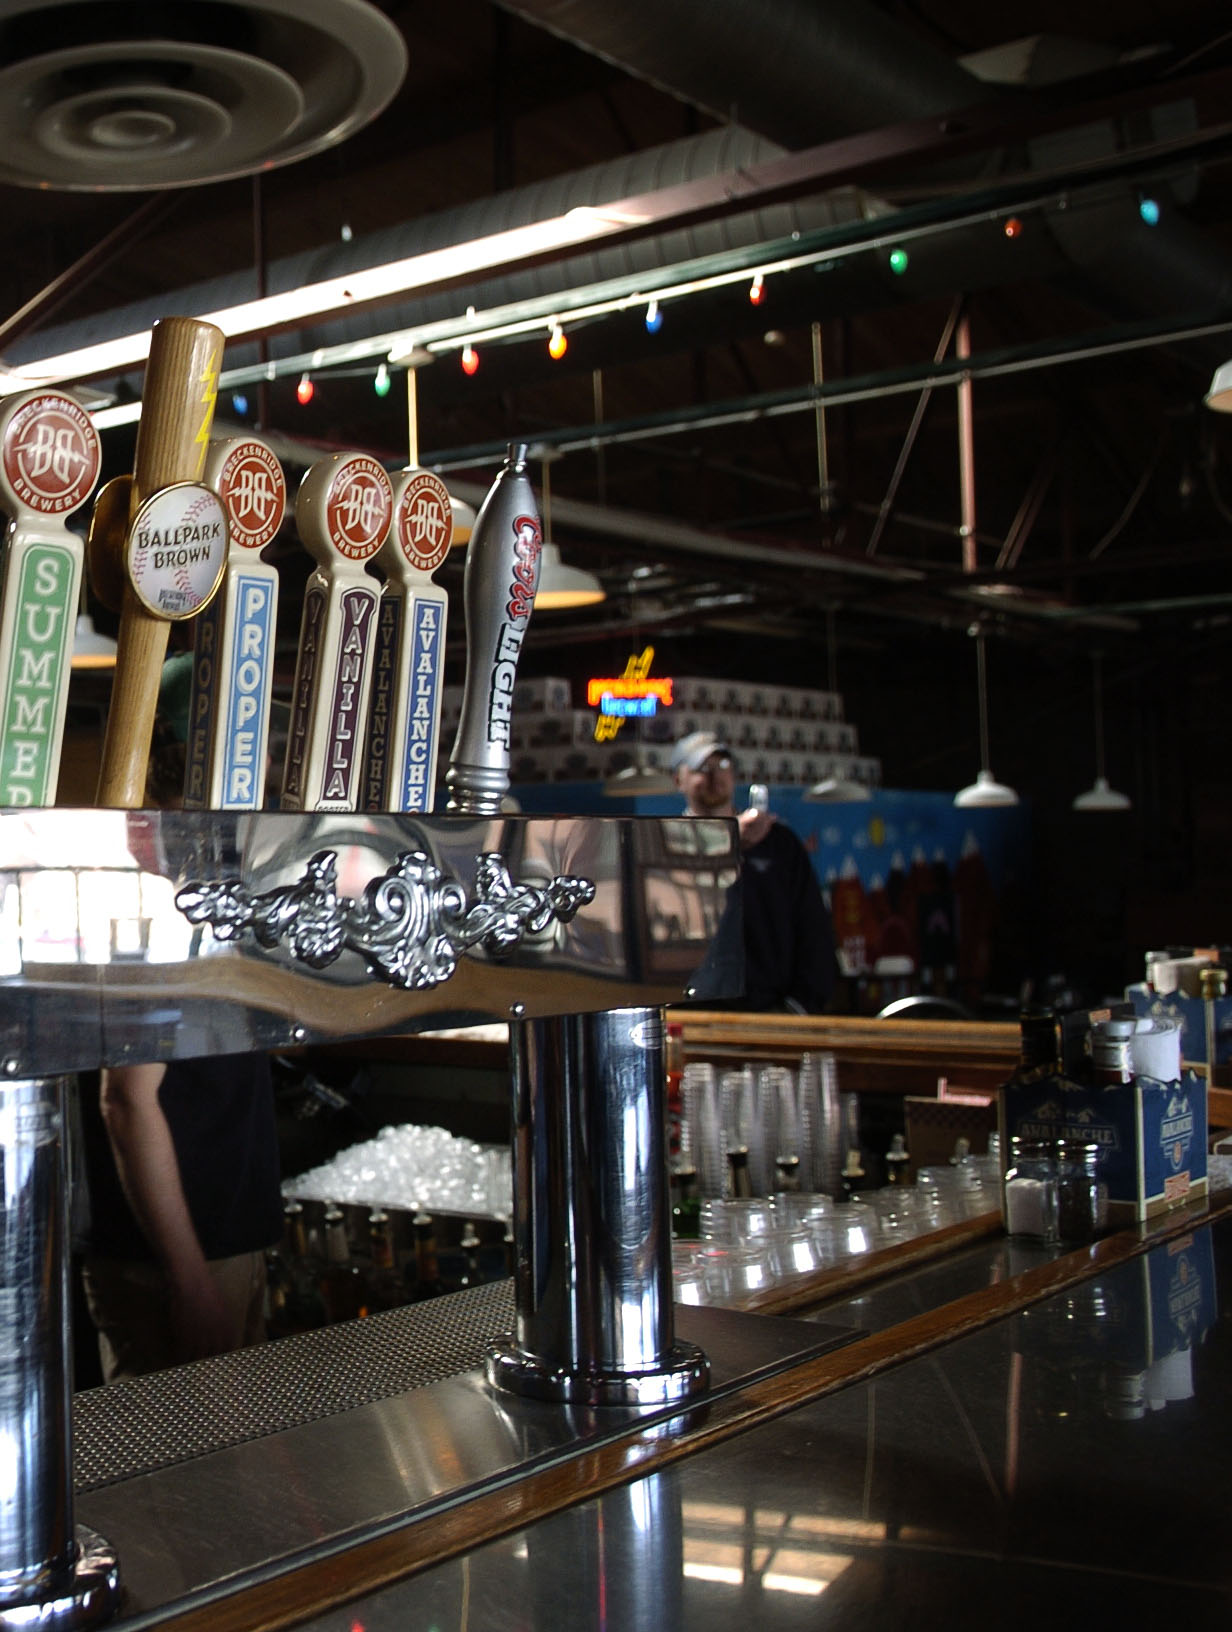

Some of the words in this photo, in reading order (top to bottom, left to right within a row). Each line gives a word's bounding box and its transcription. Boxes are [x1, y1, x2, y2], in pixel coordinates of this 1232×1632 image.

[223, 446, 283, 488] BRECKENRIDGE
[333, 460, 391, 503] BRECKENRIDGE
[13, 478, 81, 511] BREWERY
[403, 476, 451, 517] BRECKENRIDGE
[138, 523, 220, 548] BALLPARK
[154, 545, 211, 568] BROWN
[333, 531, 379, 557] BREWERY
[404, 544, 444, 568] BREWERY
[188, 604, 217, 798] ROPER
[230, 587, 265, 802] PROPER
[288, 598, 323, 793] VANILLA
[325, 597, 370, 798] VANILLA
[368, 604, 395, 801] AVALANCHE
[407, 608, 437, 807] AVALANCHE
[488, 623, 525, 751] LIGHT
[1020, 1122, 1114, 1145] AVALANCHE
